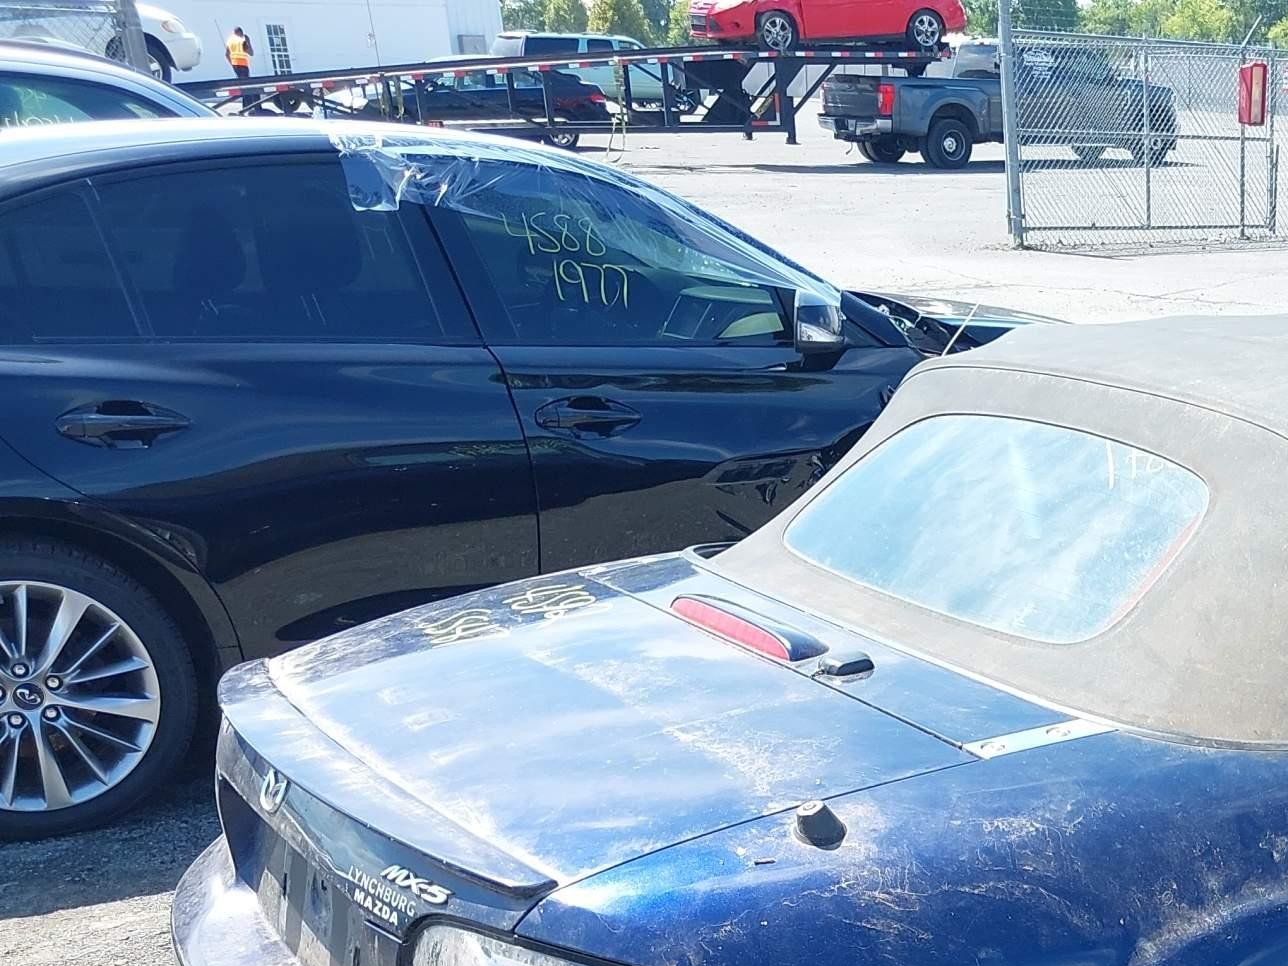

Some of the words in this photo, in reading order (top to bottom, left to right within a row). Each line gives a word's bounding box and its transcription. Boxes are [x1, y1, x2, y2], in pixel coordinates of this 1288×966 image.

[501, 212, 606, 256] 4588
[348, 865, 417, 917] LYNCHBURG
[380, 864, 452, 904] MX-5
[353, 888, 399, 926] MAZDA
